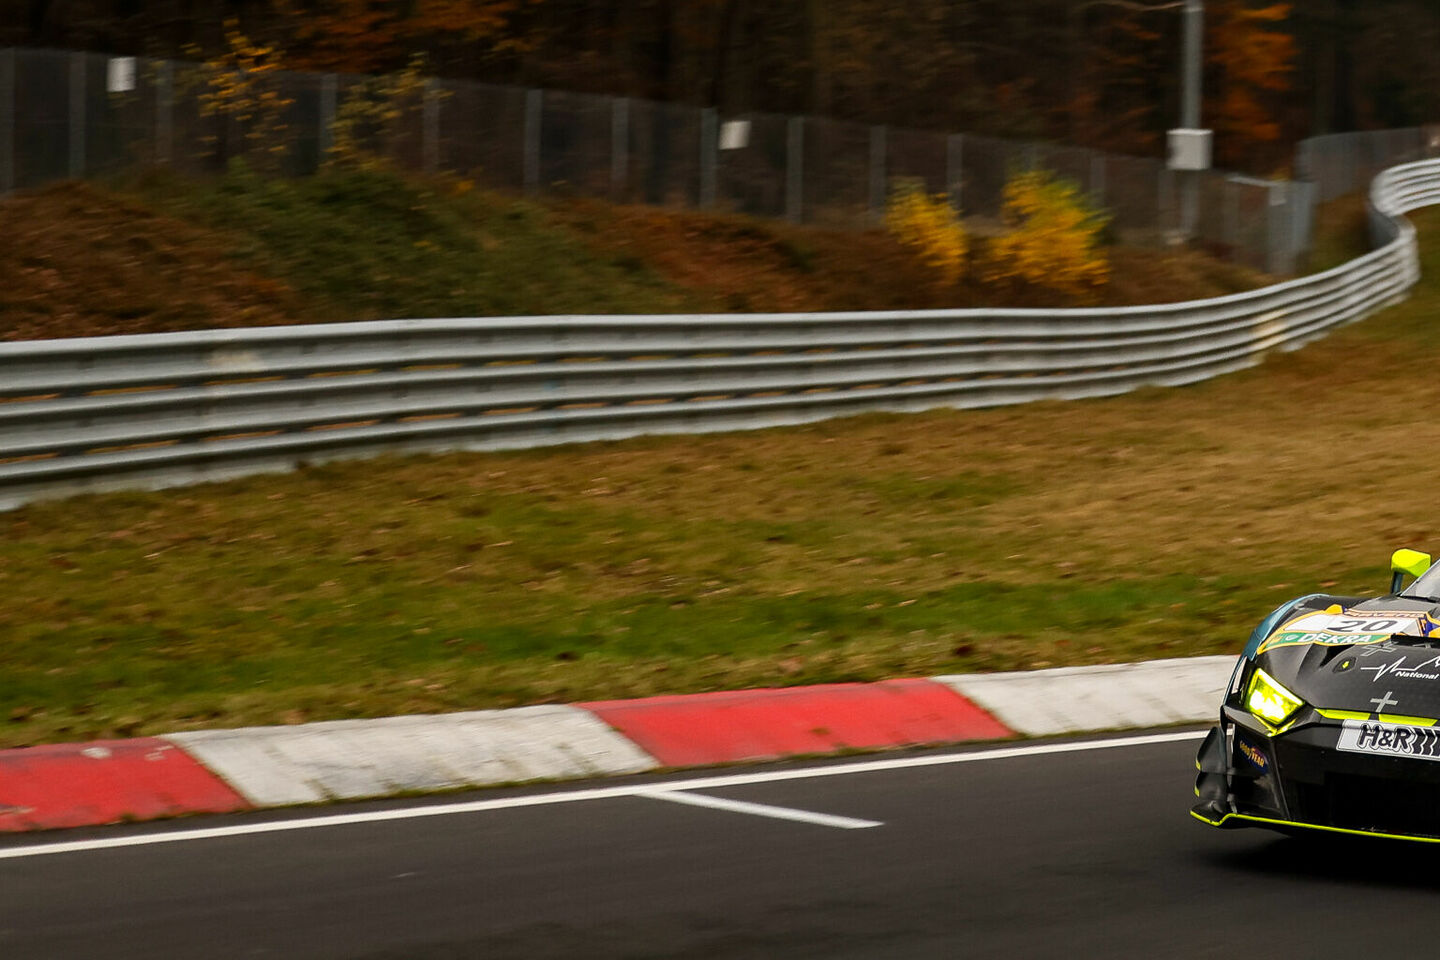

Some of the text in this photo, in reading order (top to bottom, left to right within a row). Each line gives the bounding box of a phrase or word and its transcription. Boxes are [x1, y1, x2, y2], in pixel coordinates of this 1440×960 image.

[1327, 619, 1398, 633] 20
[1296, 632, 1371, 644] DEKRA
[1395, 670, 1438, 681] National
[1357, 723, 1412, 752] H&R
